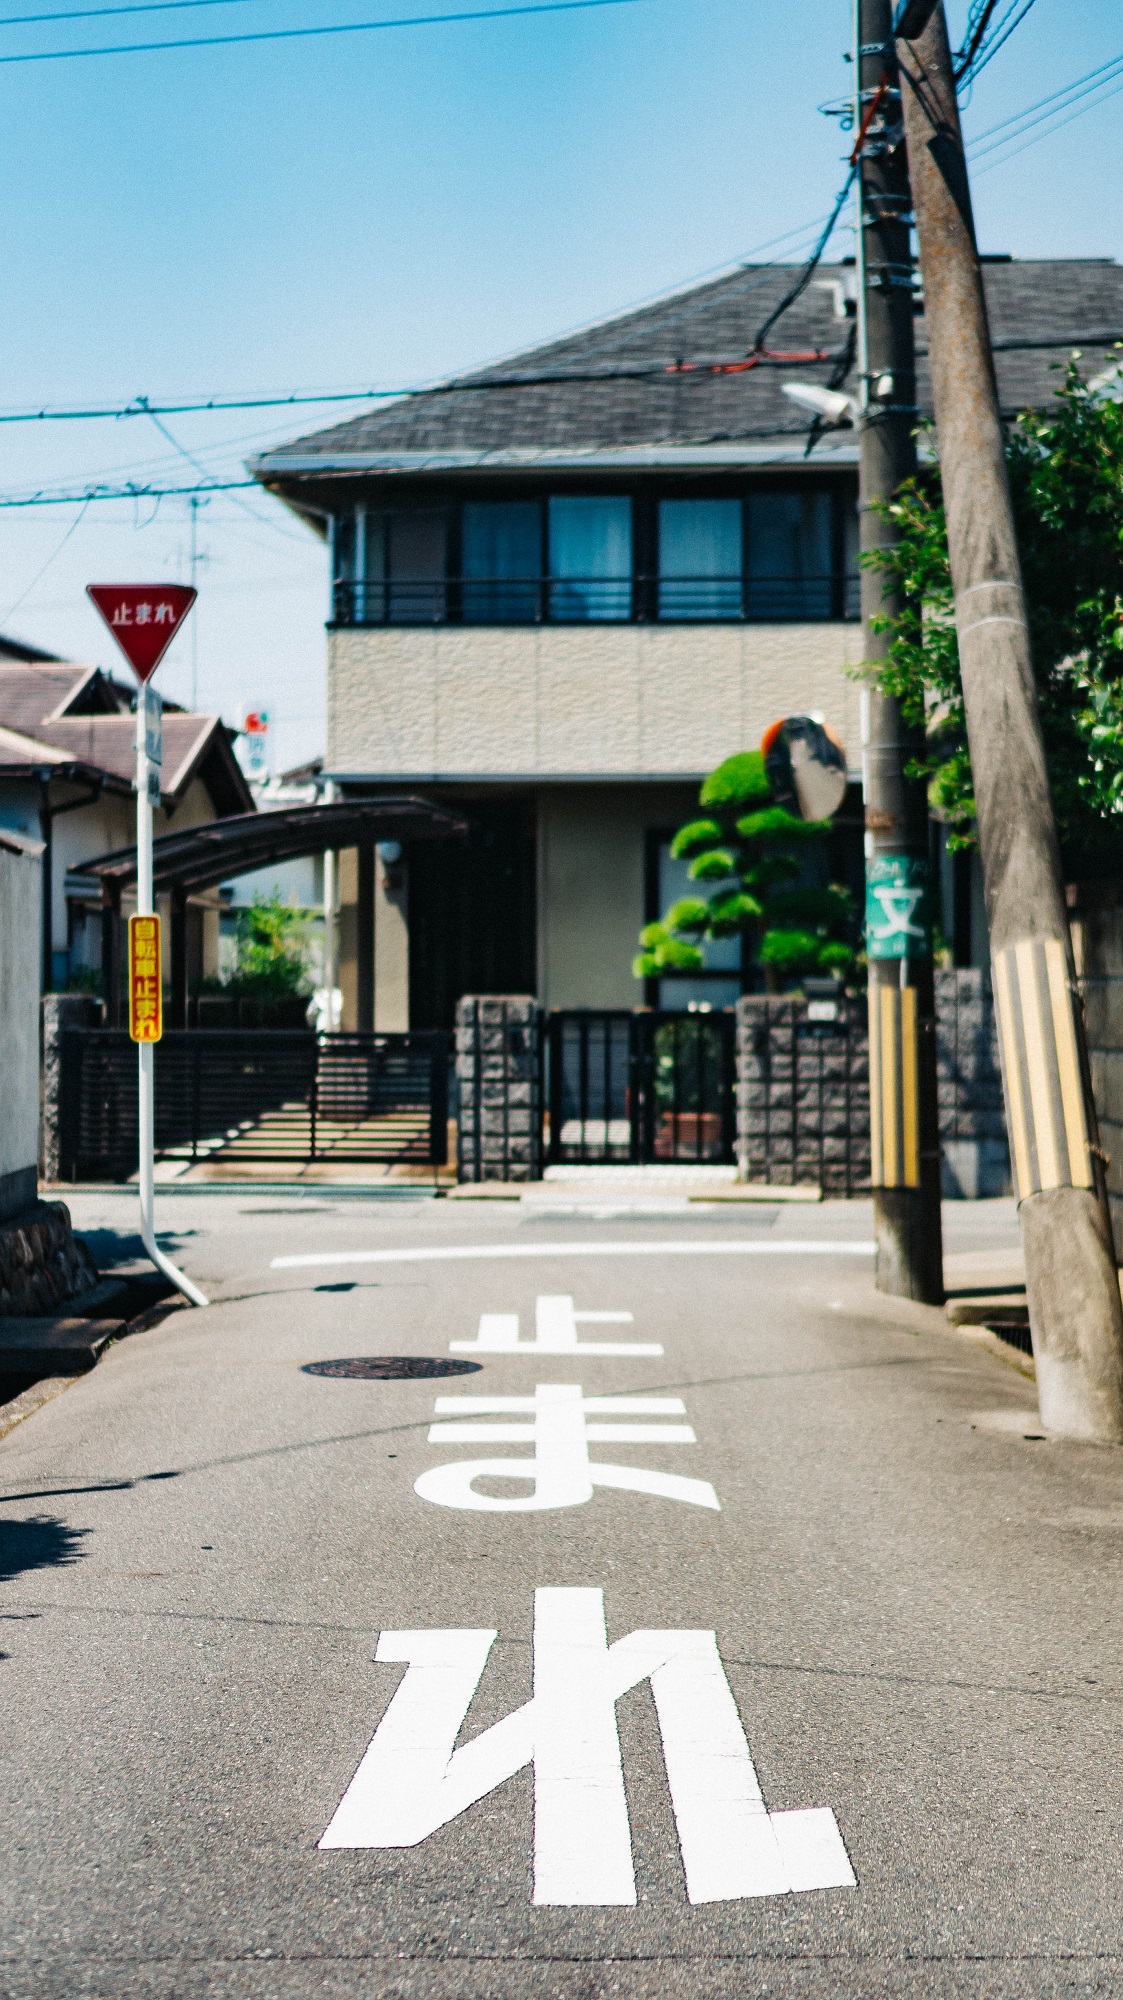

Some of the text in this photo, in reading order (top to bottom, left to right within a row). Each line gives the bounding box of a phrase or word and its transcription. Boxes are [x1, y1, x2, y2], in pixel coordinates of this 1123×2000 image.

[110, 601, 177, 626] 止まれ
[134, 918, 158, 1038] 自転車止まれ
[317, 1295, 858, 1906] 止まれ
